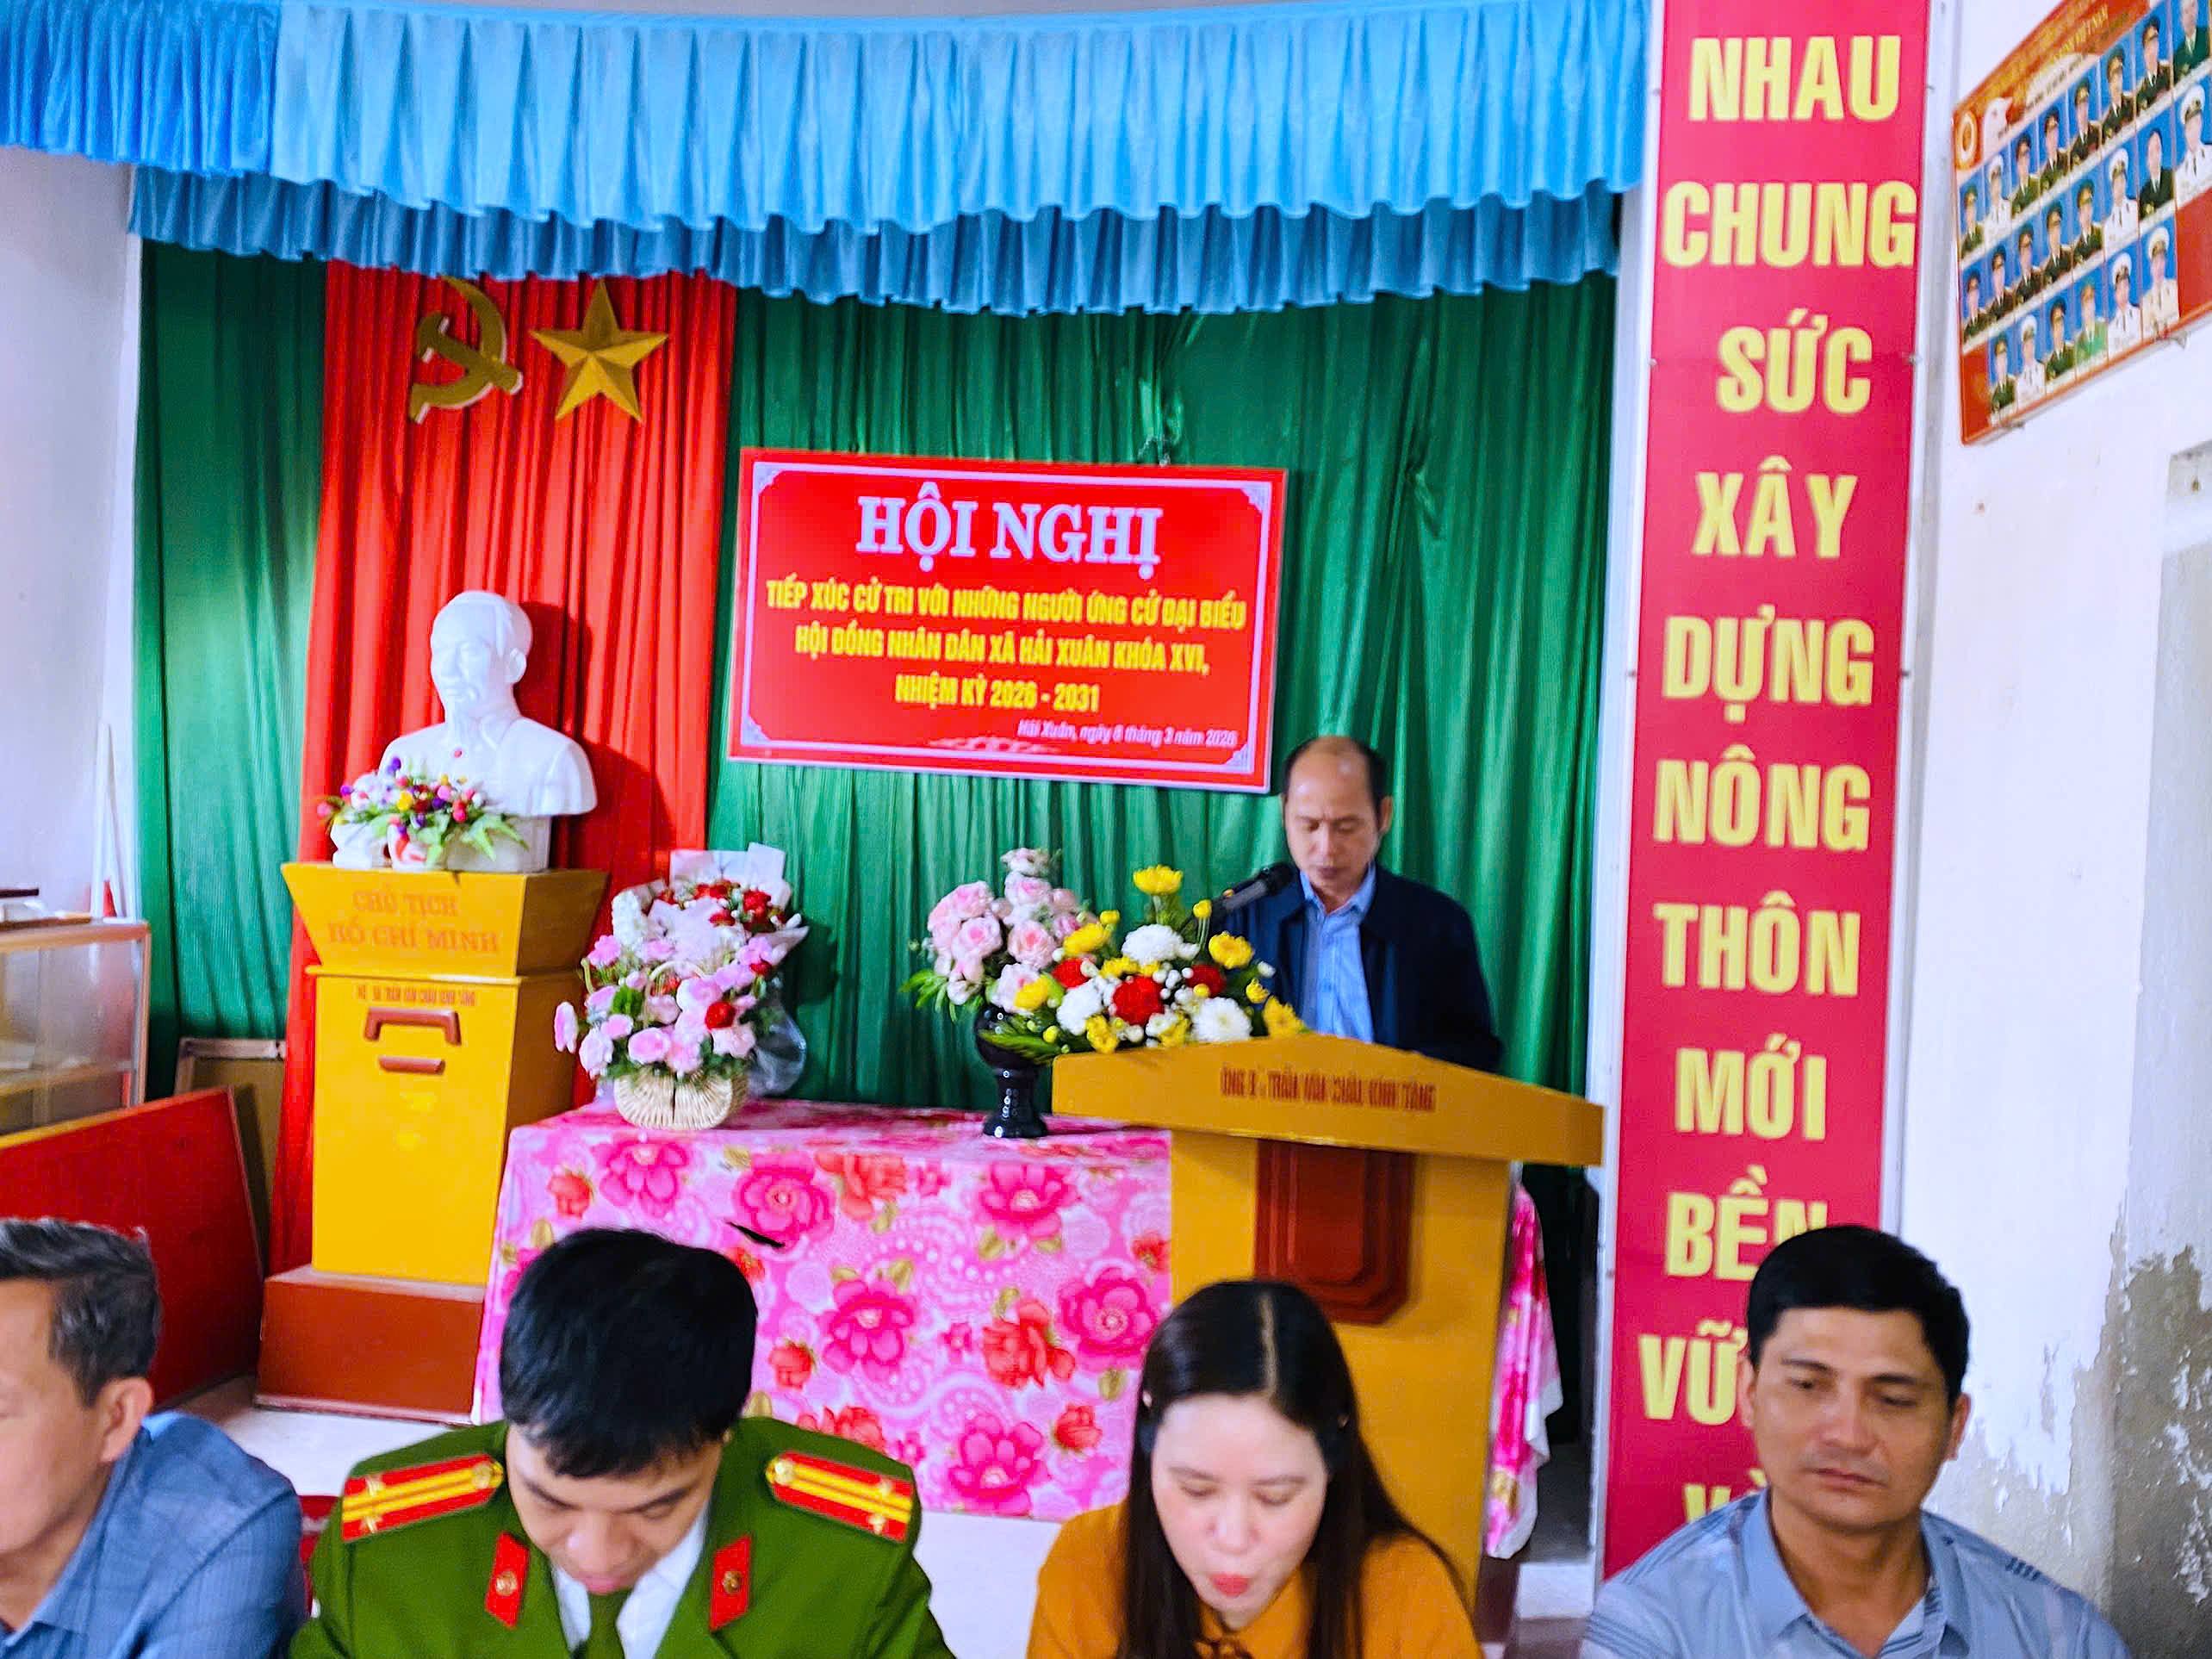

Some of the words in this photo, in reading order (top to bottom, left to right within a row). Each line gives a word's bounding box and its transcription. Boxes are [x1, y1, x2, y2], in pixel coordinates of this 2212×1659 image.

[1688, 35, 1901, 122] NHAU
[1662, 180, 1918, 269] CHUNG
[1716, 308, 1873, 414] SỨC
[856, 482, 978, 572] HỘI
[991, 501, 1162, 580] NGHỊ
[1692, 454, 1859, 560] XÂY
[767, 572, 807, 608] TIẾP
[811, 576, 850, 612] XÚC
[884, 586, 914, 614] TRI
[918, 582, 949, 617] VỚI
[795, 620, 829, 660] HỘI
[887, 626, 941, 660] NHÂN
[1055, 634, 1110, 668] XUÂN
[895, 670, 958, 710] NHIỆM
[1053, 681, 1099, 712] 2031
[1662, 603, 1875, 724] DỰNG
[1653, 743, 1872, 852] NÔNG
[1653, 889, 1861, 997] THÔN
[1675, 1033, 1827, 1141] MỚI
[1638, 1320, 1749, 1426] VỮ
